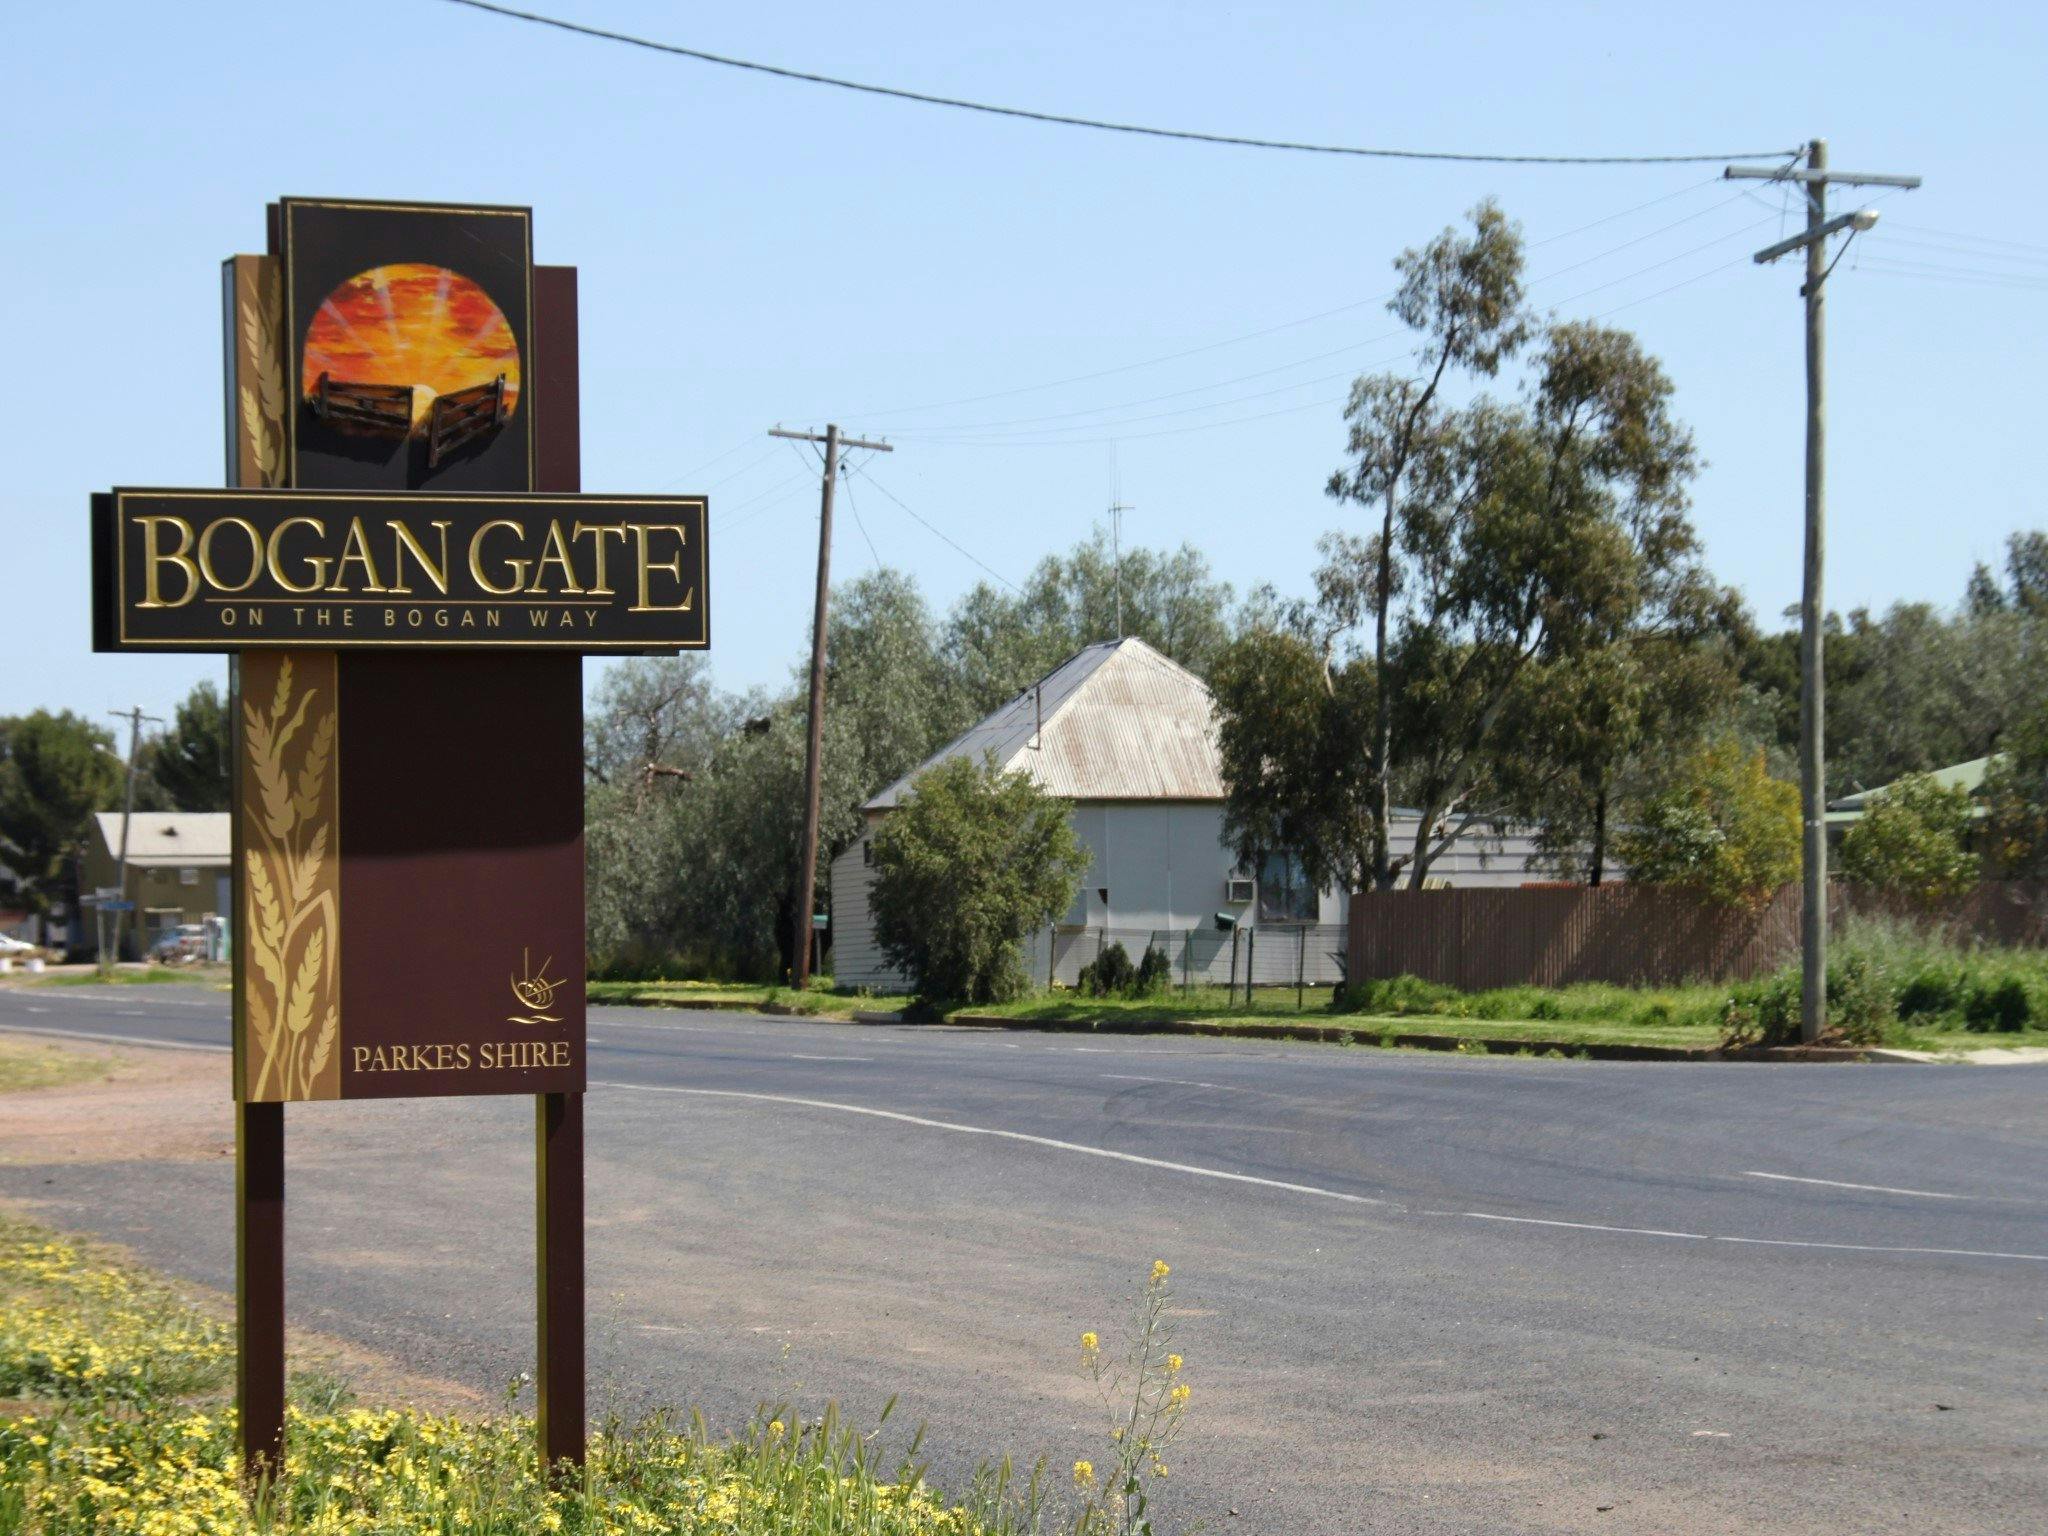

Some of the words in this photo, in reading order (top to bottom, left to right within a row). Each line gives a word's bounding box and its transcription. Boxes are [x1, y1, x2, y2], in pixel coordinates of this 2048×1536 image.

[132, 515, 453, 608] BOGAN
[468, 519, 693, 612] GATE
[221, 608, 263, 626] ON
[293, 608, 355, 627] THE
[384, 609, 501, 628] BOGAN
[530, 609, 599, 628] WAY
[353, 1043, 472, 1072] PARKES
[480, 1041, 571, 1069] SHIRE
